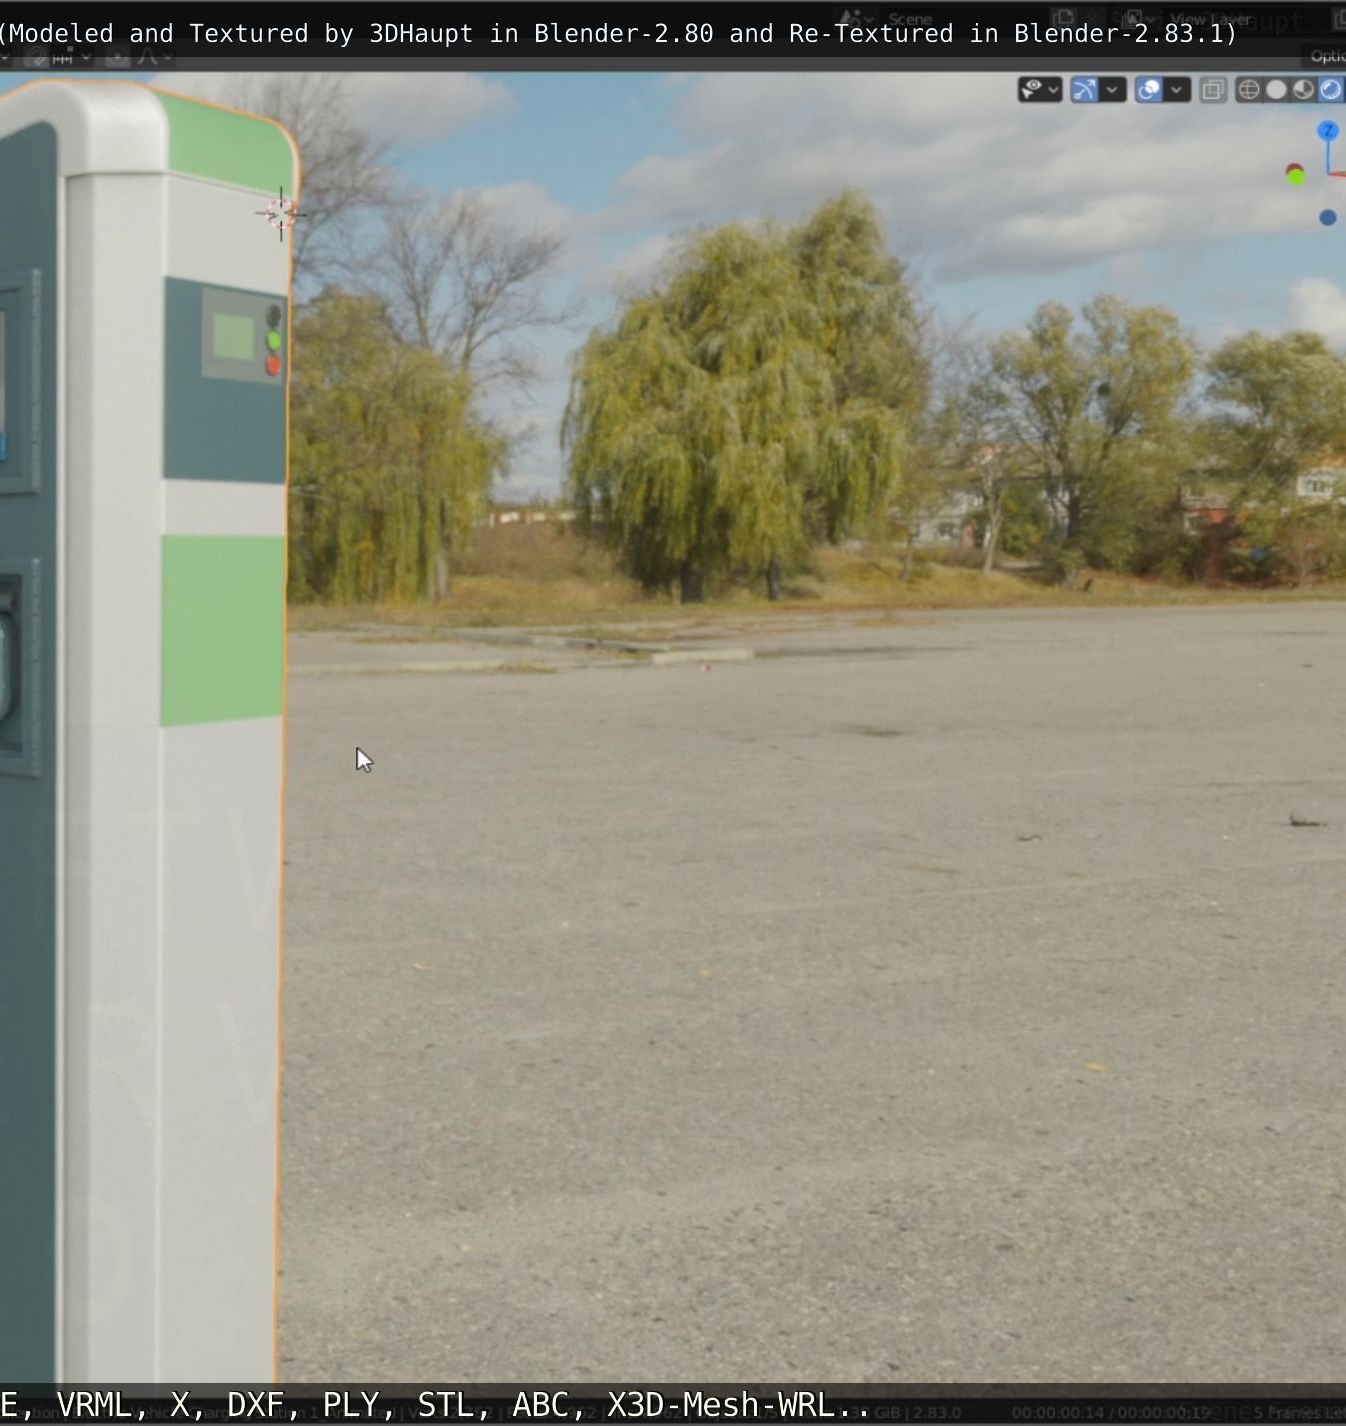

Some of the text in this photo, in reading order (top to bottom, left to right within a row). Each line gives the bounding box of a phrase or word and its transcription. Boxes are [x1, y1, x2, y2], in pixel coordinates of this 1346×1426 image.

[888, 13, 934, 26] Scene
[1170, 13, 1207, 26] View
[1211, 13, 1251, 29] Layer
[1323, 124, 1334, 136] Z
[912, 1406, 962, 1419] 2.83.0
